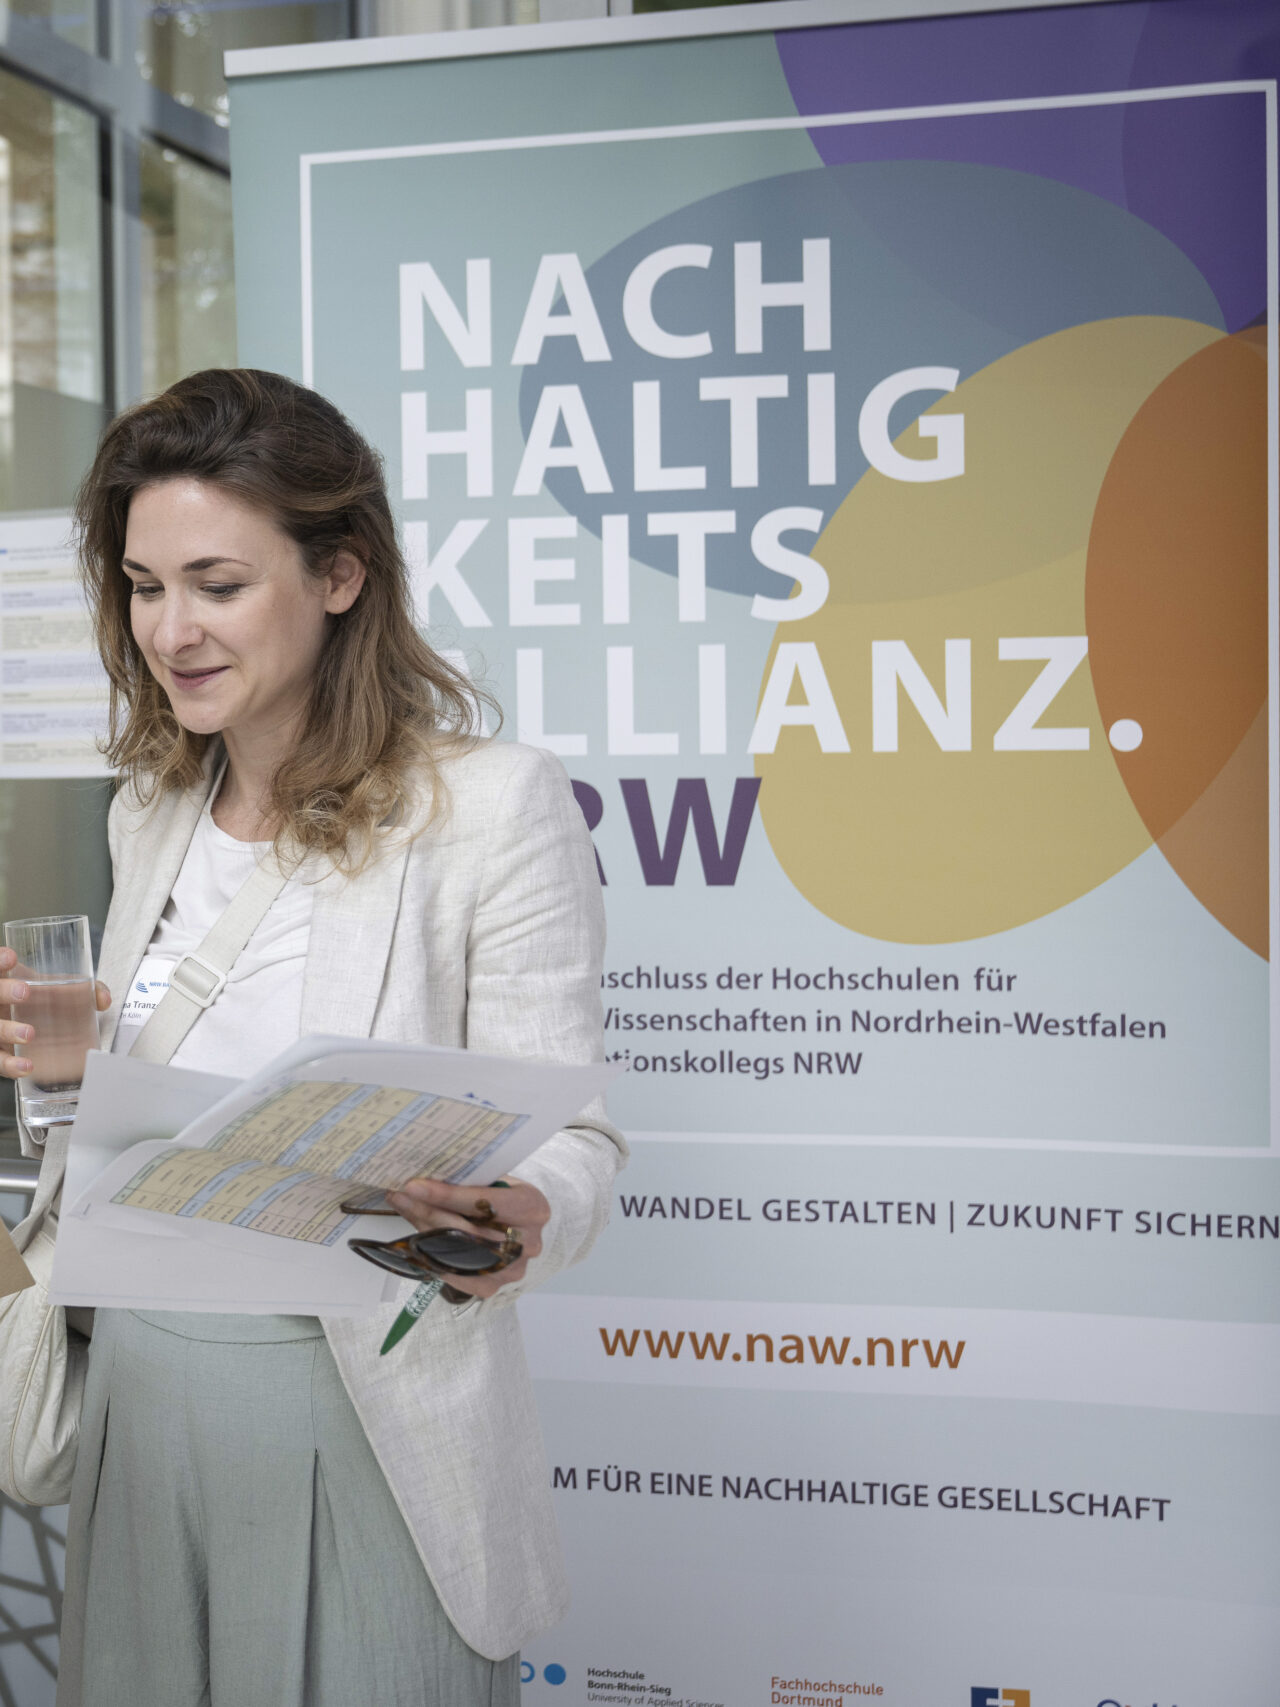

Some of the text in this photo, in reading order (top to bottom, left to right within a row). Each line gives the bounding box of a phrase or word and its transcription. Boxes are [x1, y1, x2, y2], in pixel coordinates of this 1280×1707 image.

[400, 238, 832, 371] NACH
[400, 366, 965, 499] HALTIG
[403, 507, 829, 628] KEITS
[716, 966, 763, 990] der
[772, 967, 959, 991] Hochschulen
[973, 967, 1017, 992] für
[133, 1000, 160, 1010] Tranz
[816, 1010, 841, 1033] in
[851, 1010, 1167, 1039] Nordrhein-Westfalen
[793, 1051, 863, 1075] NRW
[620, 1195, 752, 1221] WANDEL
[762, 1199, 936, 1226] GESTALTEN
[966, 1203, 1124, 1233] ZUKUNFT
[1135, 1210, 1280, 1240] SICHERN
[598, 1327, 966, 1369] www.naw.nrw
[553, 1464, 1171, 1522] M FÜR EINE NACHHALTIGE GESELLSCHAFT
[587, 1668, 645, 1680] Hochschule
[587, 1679, 672, 1696] Bonn-Rhein-Sieg
[771, 1676, 884, 1696] Fachhochschule
[771, 1691, 843, 1707] Dortmund
